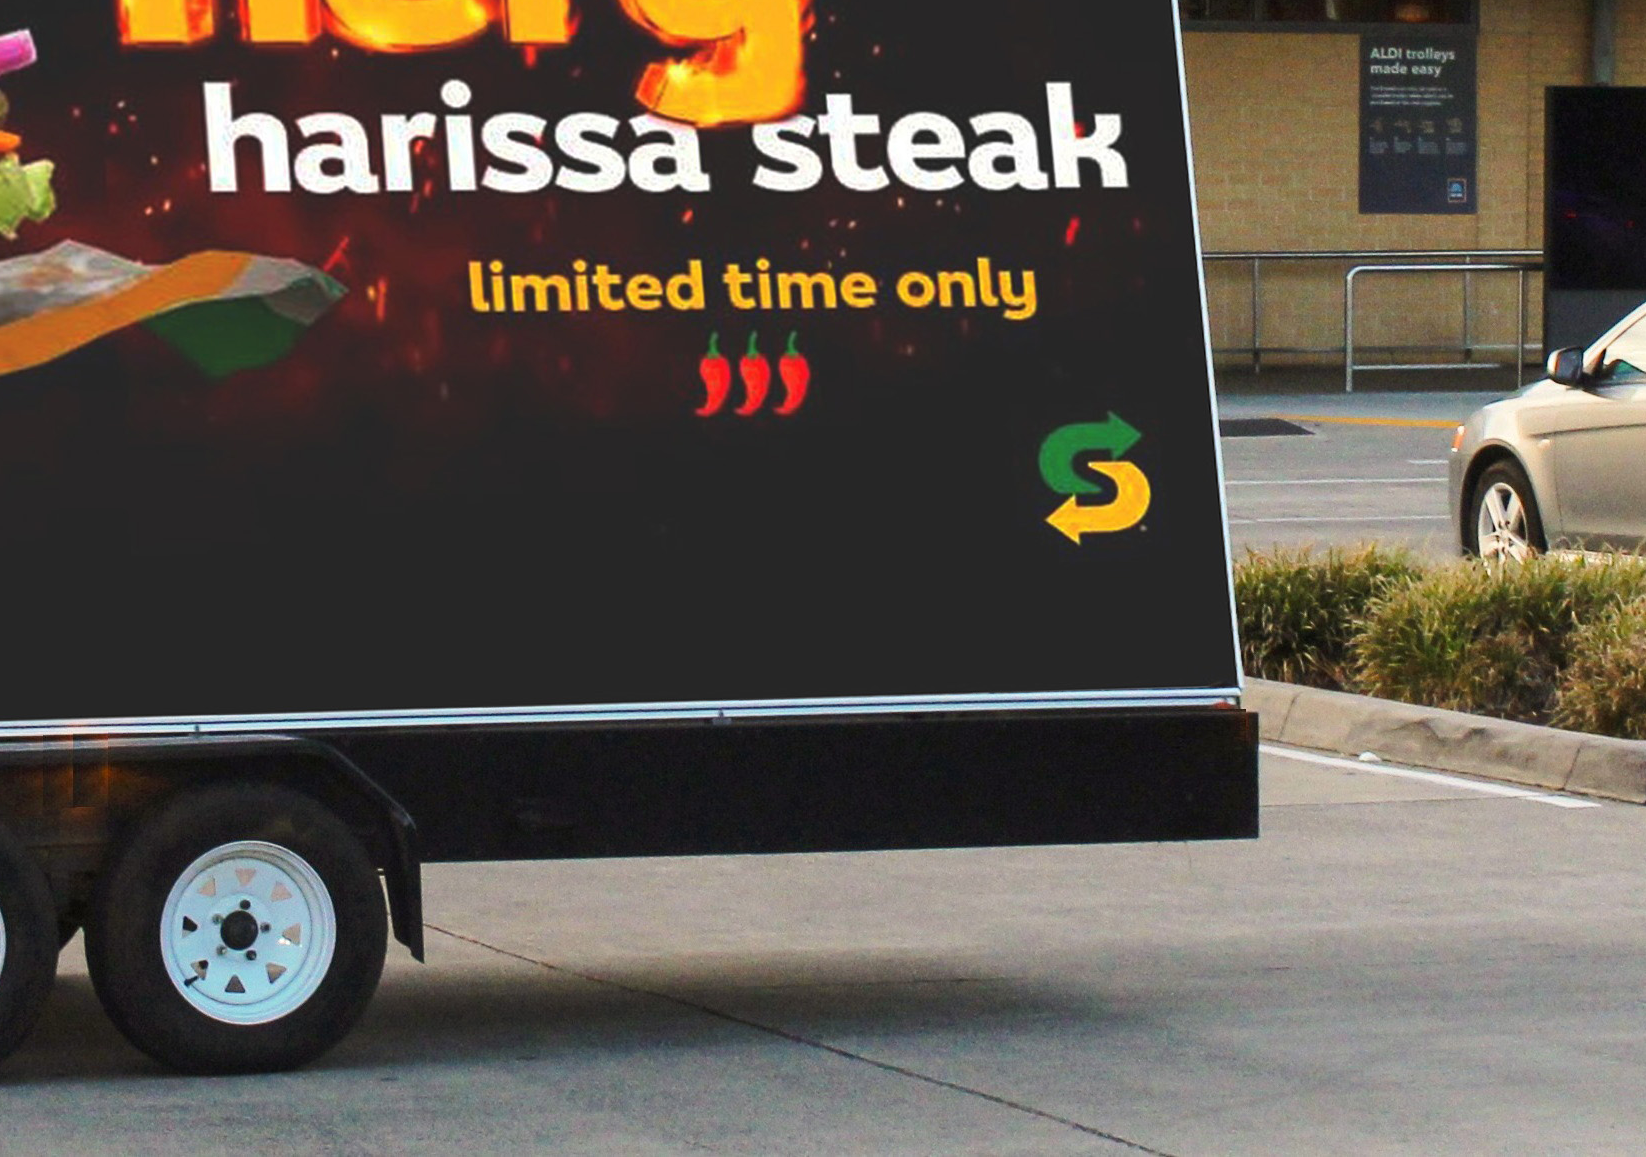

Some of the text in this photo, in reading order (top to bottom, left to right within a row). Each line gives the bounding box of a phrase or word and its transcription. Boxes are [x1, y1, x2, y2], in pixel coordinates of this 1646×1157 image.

[1370, 47, 1455, 63] ALDI trolleys
[1370, 62, 1442, 78] made easy
[203, 79, 1129, 193] harissa steak
[468, 257, 1039, 320] limited time only
